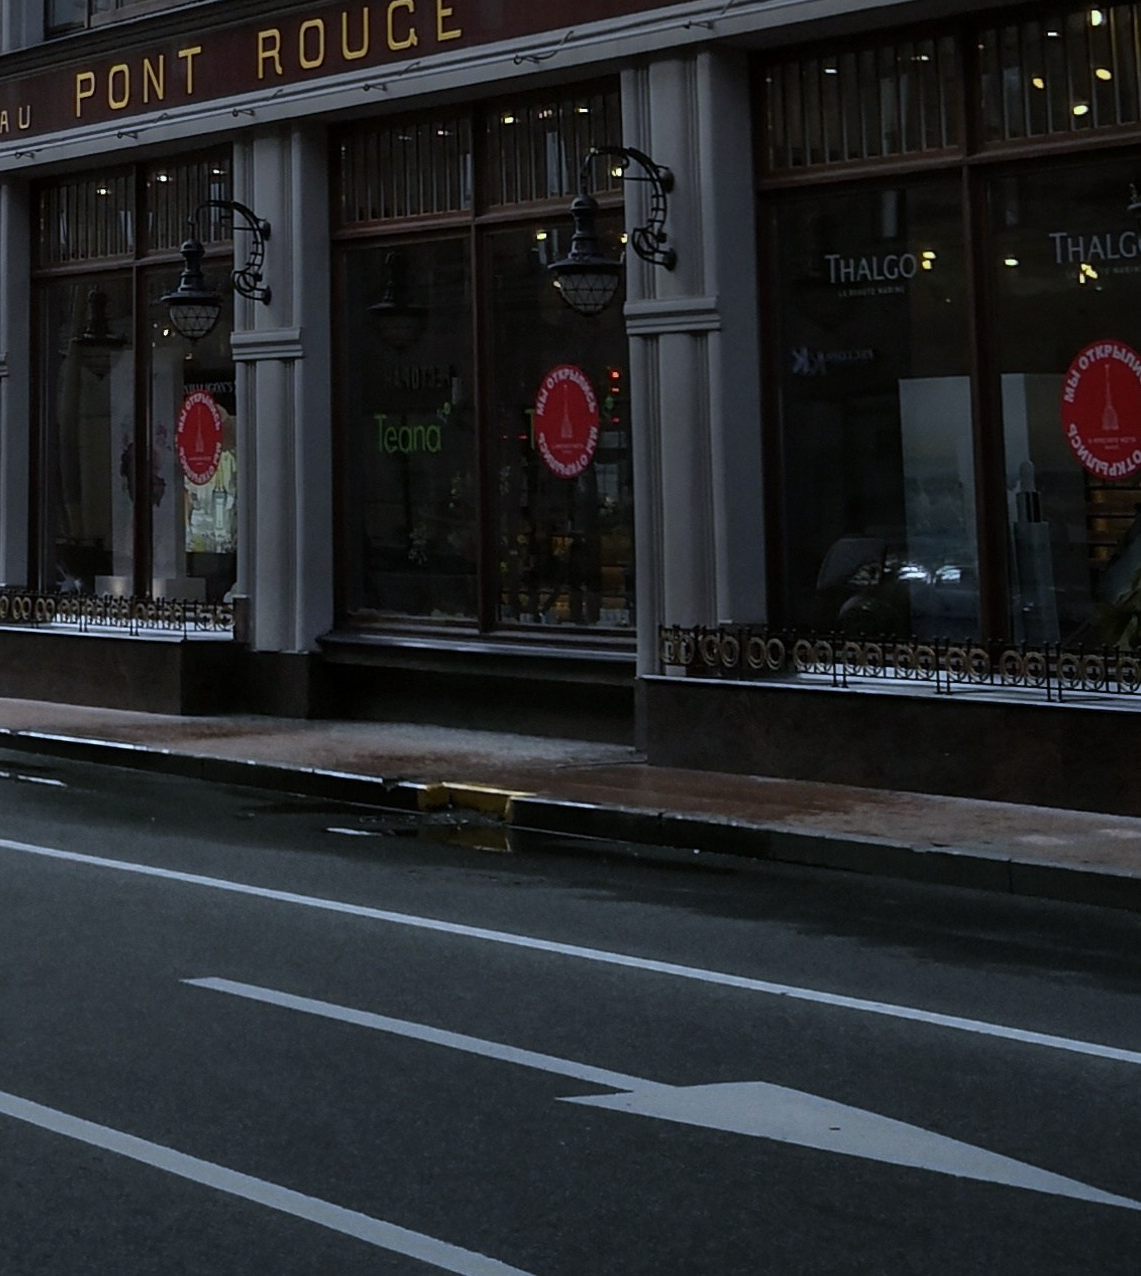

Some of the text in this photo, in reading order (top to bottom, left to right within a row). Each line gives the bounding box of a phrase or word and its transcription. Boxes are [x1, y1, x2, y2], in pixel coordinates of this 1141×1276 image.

[0, 104, 32, 134] AU
[76, 45, 202, 118] PONT
[1048, 231, 1141, 264] THALG
[824, 253, 917, 284] THALGO
[1078, 344, 1141, 385] ОТКРЫЛИ
[371, 413, 442, 453] Teana
